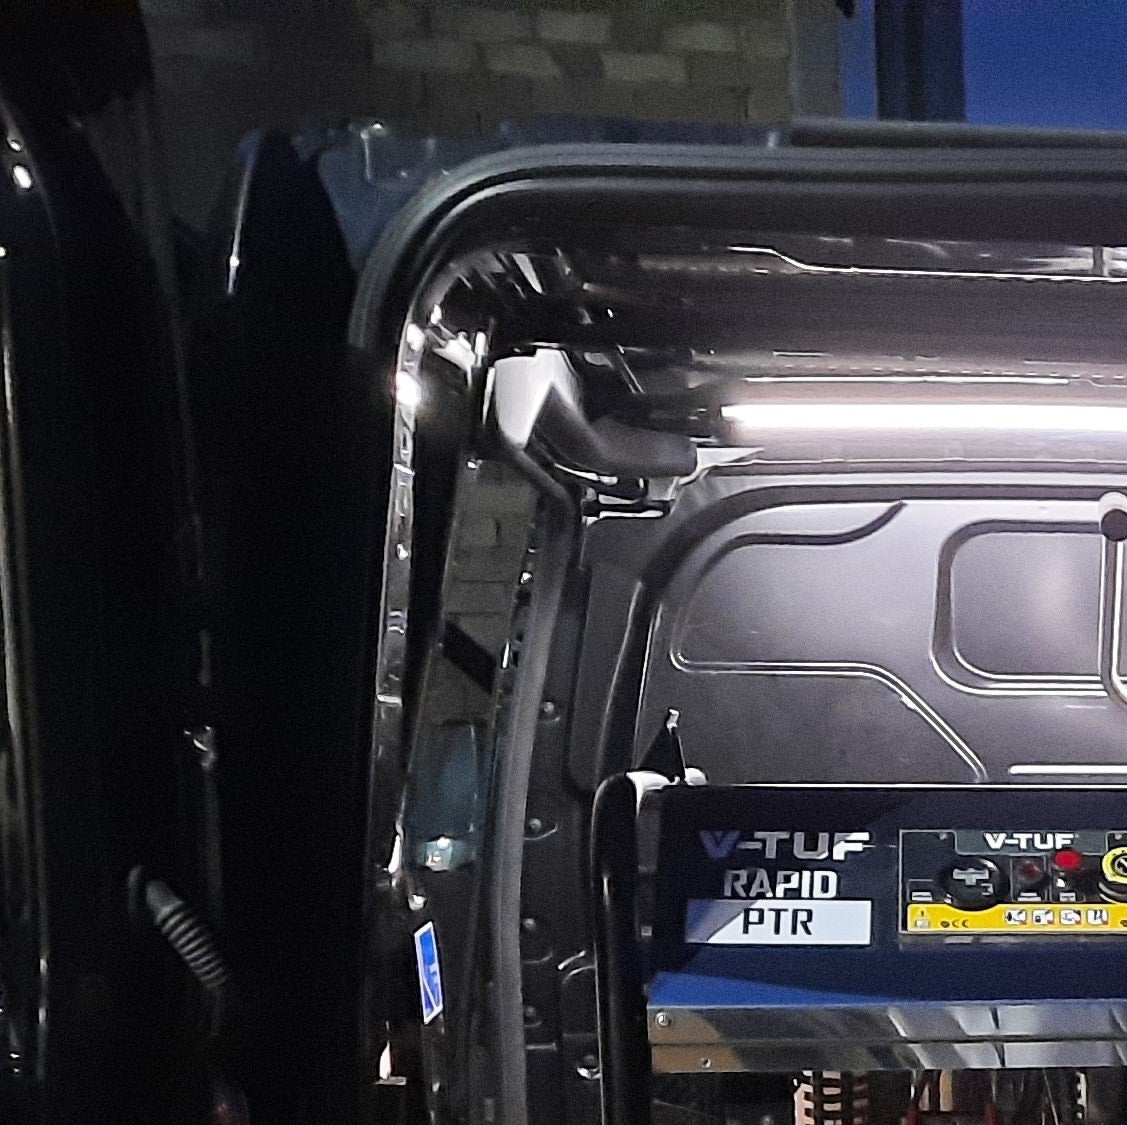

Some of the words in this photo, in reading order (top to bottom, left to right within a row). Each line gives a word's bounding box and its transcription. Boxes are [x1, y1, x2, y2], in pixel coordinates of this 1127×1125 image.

[700, 830, 870, 861] V-TUF
[983, 832, 1076, 850] V-TUF
[723, 868, 838, 899] RAPID
[742, 907, 814, 936] PTR
